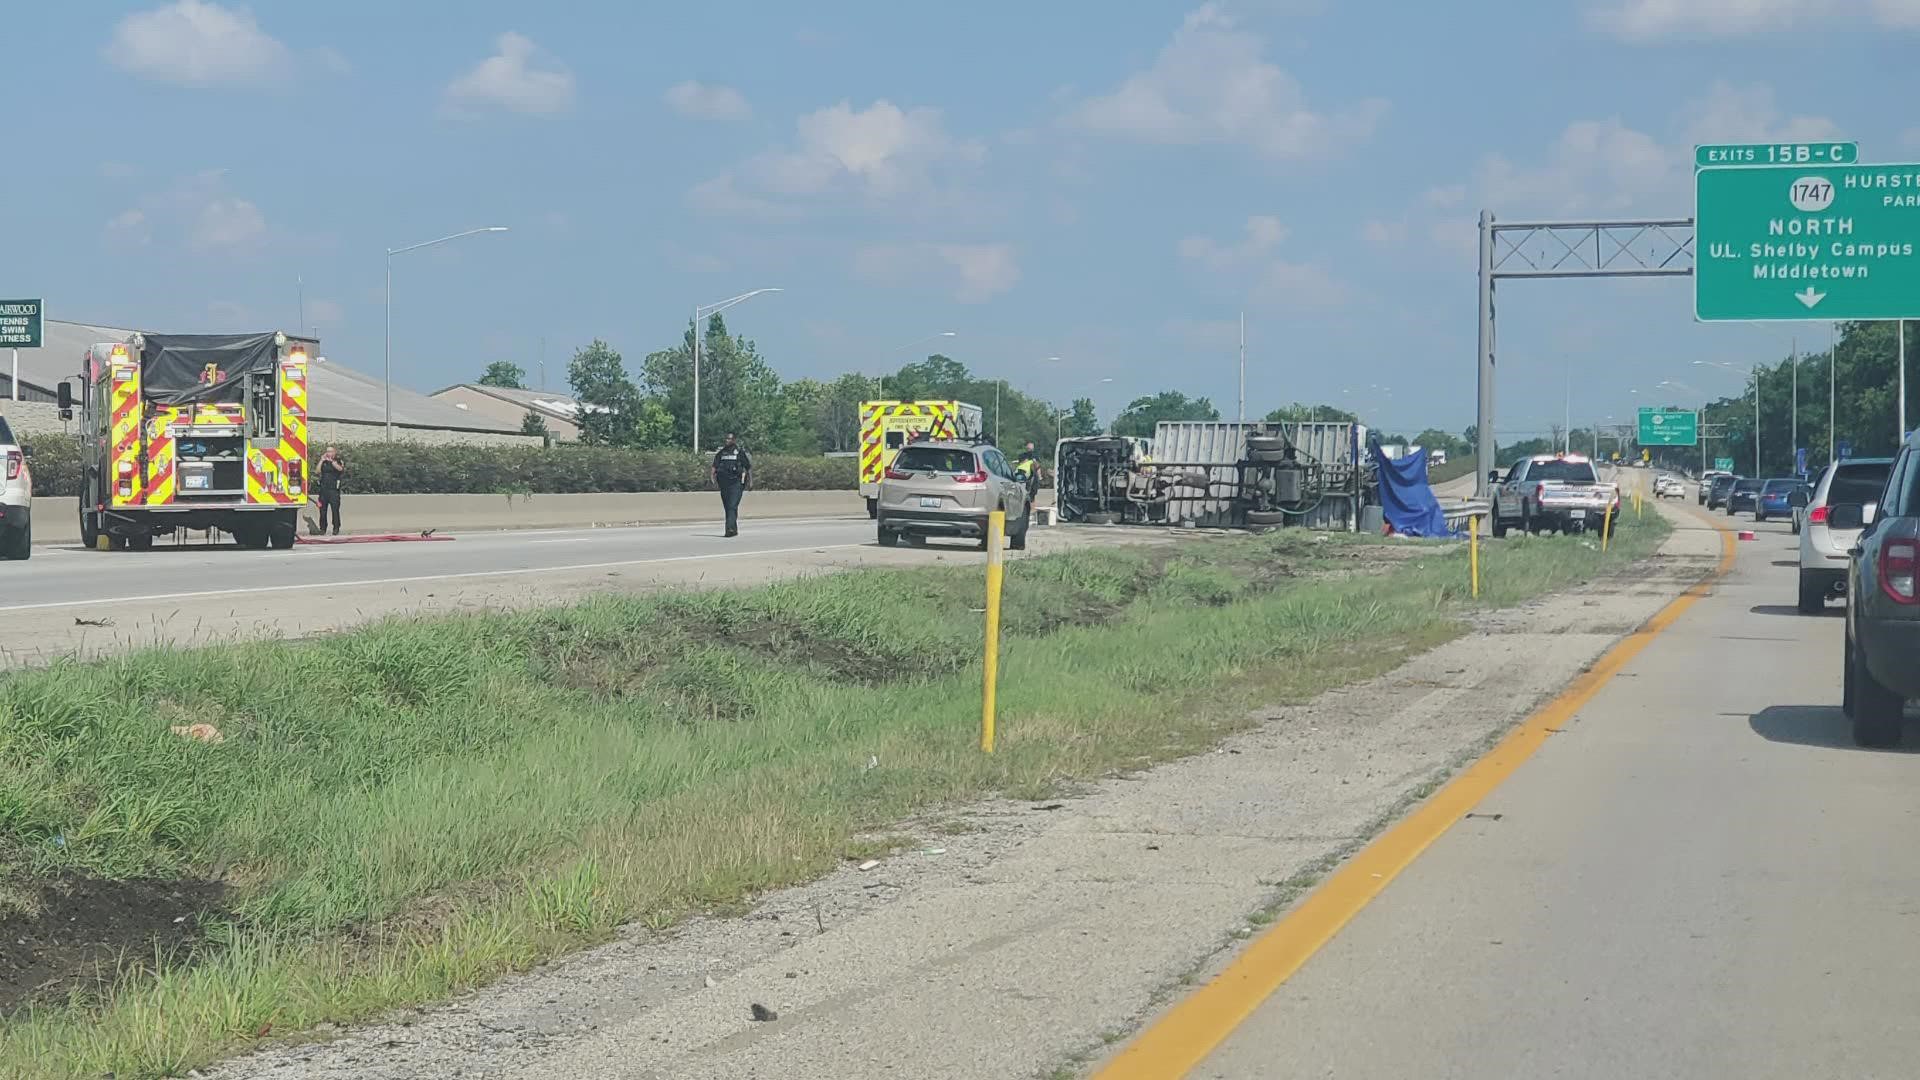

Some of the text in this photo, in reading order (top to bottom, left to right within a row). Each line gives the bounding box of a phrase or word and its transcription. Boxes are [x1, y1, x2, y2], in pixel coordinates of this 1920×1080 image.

[1708, 146, 1843, 162] EXITS 15B-C
[1792, 184, 1832, 202] 1747
[1883, 195, 1920, 207] PAR
[1769, 217, 1853, 235] NORTH
[1750, 243, 1819, 260] Shelby
[1831, 242, 1913, 258] Campus
[1753, 264, 1869, 279] Middletown
